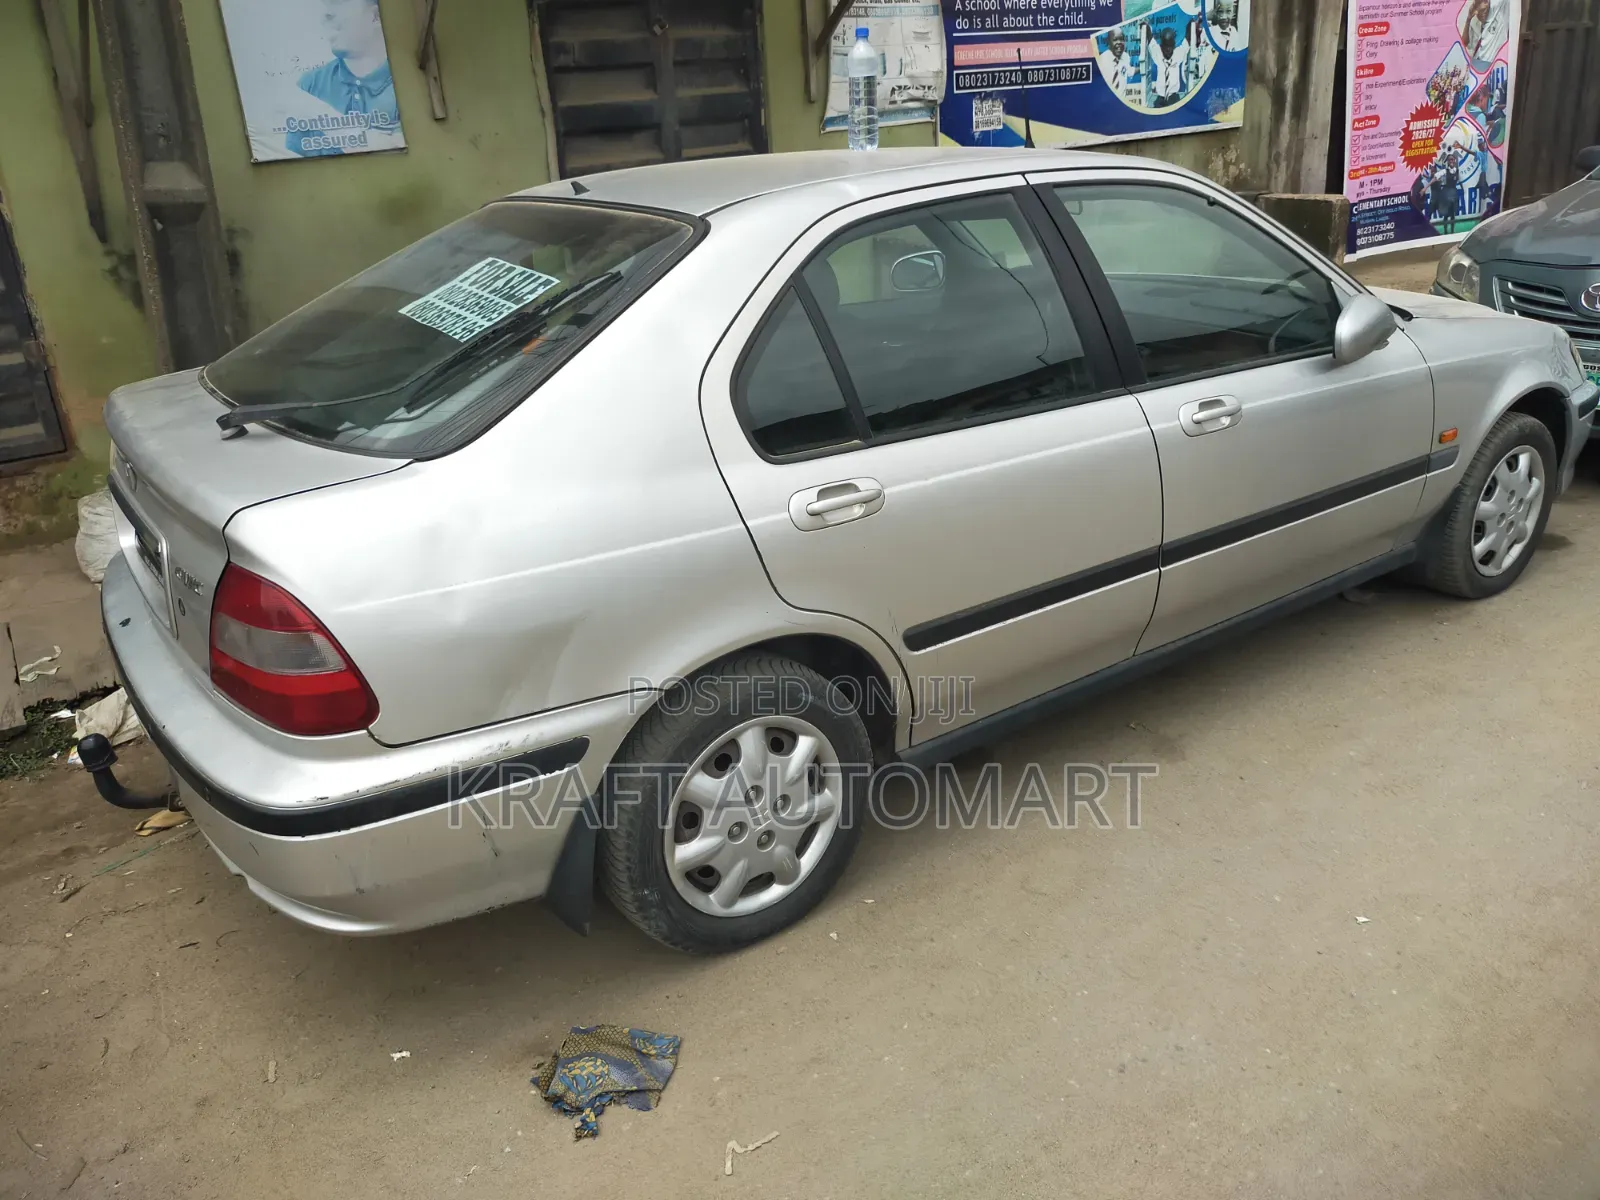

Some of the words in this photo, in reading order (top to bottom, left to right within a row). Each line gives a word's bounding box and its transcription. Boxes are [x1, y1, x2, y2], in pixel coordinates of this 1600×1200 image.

[954, 0, 963, 11] A
[965, 0, 1001, 11] school
[1003, 0, 1038, 10] where
[1041, 0, 1096, 11] everything
[955, 15, 970, 30] do
[973, 15, 982, 29] is
[985, 13, 1000, 29] all
[1002, 13, 1034, 28] about
[1037, 12, 1055, 27] the
[1058, 11, 1087, 26] child.
[1027, 67, 1087, 83] 08073108775
[374, 110, 390, 125] is
[1408, 118, 1440, 131] ADMISSION
[302, 130, 368, 150] assured
[1405, 146, 1438, 157] REGISTRATION
[1378, 163, 1394, 173] August
[1370, 178, 1383, 188] 1PM
[1369, 186, 1391, 196] Thursday
[1387, 194, 1409, 206] SCHOOL
[458, 259, 517, 292] FOR
[487, 269, 556, 306] SALE
[433, 283, 514, 322] 08028369085
[406, 299, 485, 340] 08036978196
